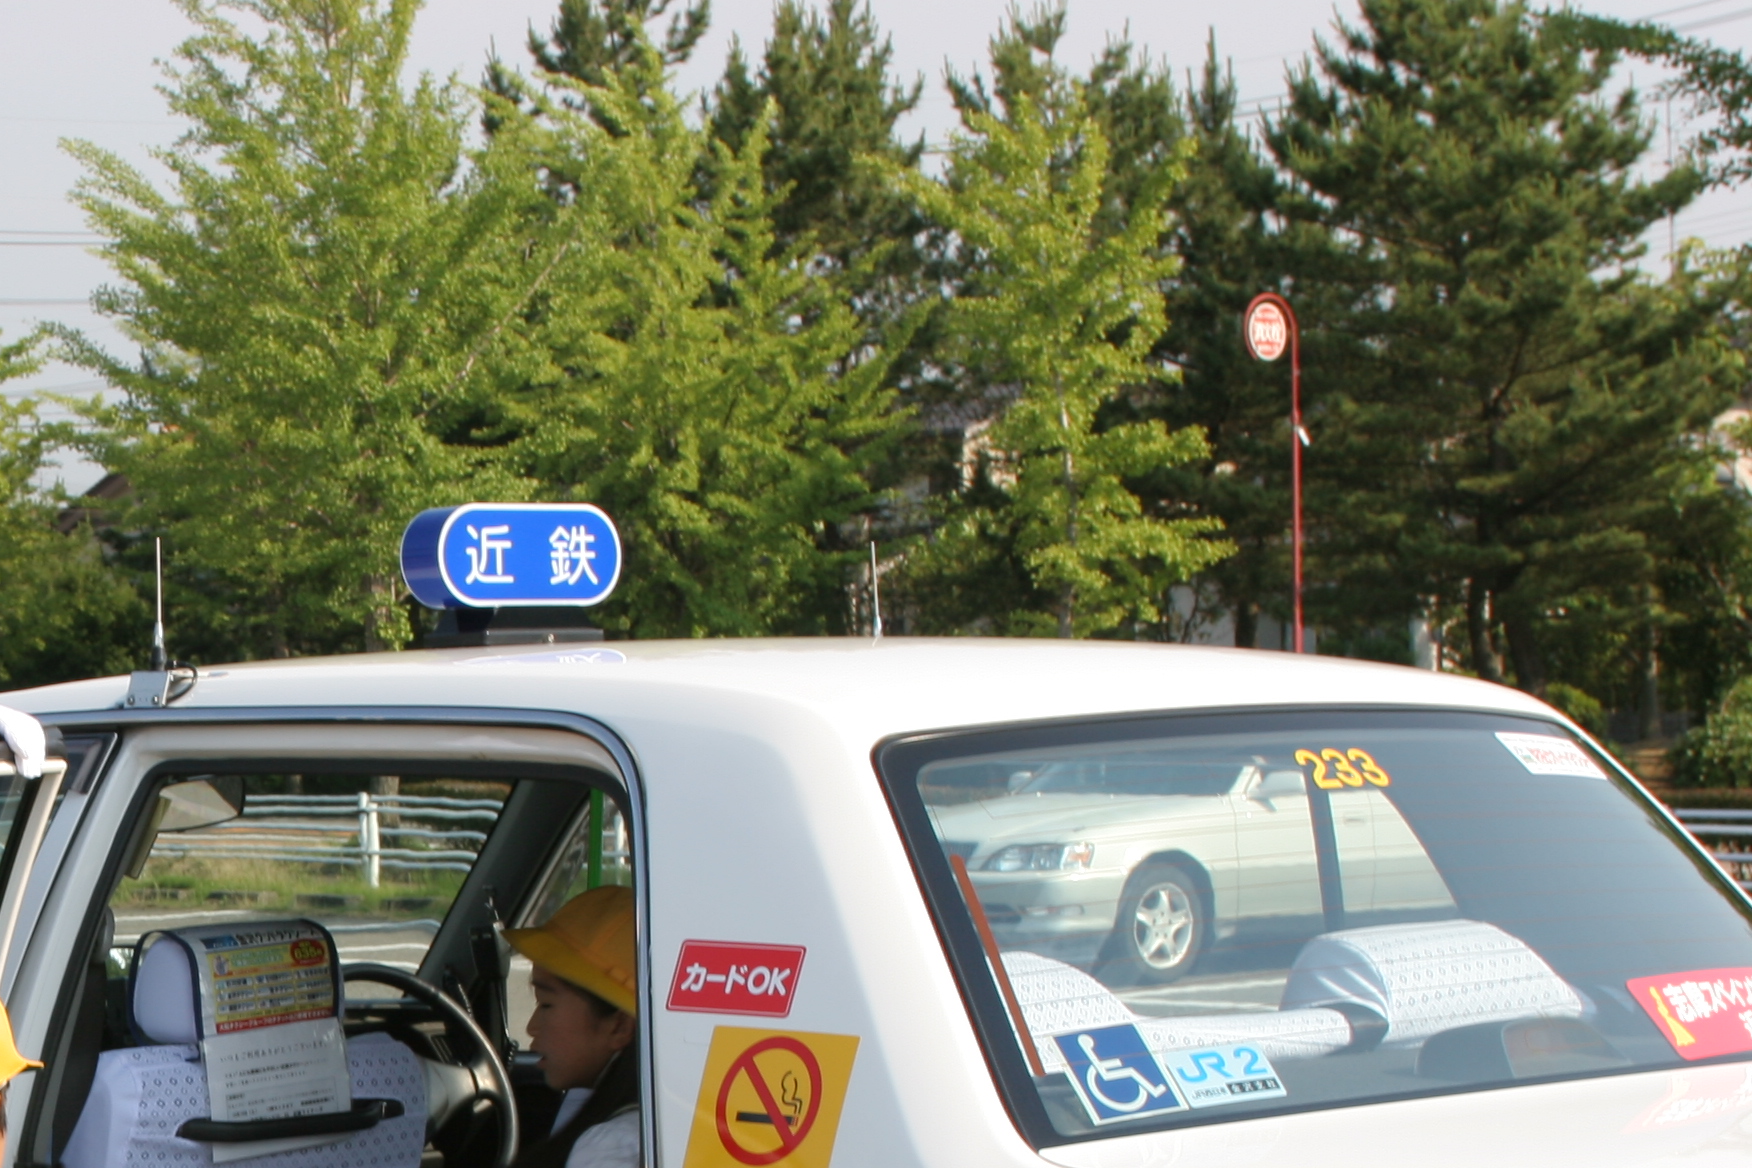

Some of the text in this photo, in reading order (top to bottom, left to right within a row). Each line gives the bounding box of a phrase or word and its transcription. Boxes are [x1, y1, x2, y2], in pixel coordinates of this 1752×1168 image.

[464, 523, 600, 587] 近鉄
[1294, 747, 1392, 790] 233
[680, 962, 791, 997] カードOK
[1176, 1046, 1268, 1083] JR 2
